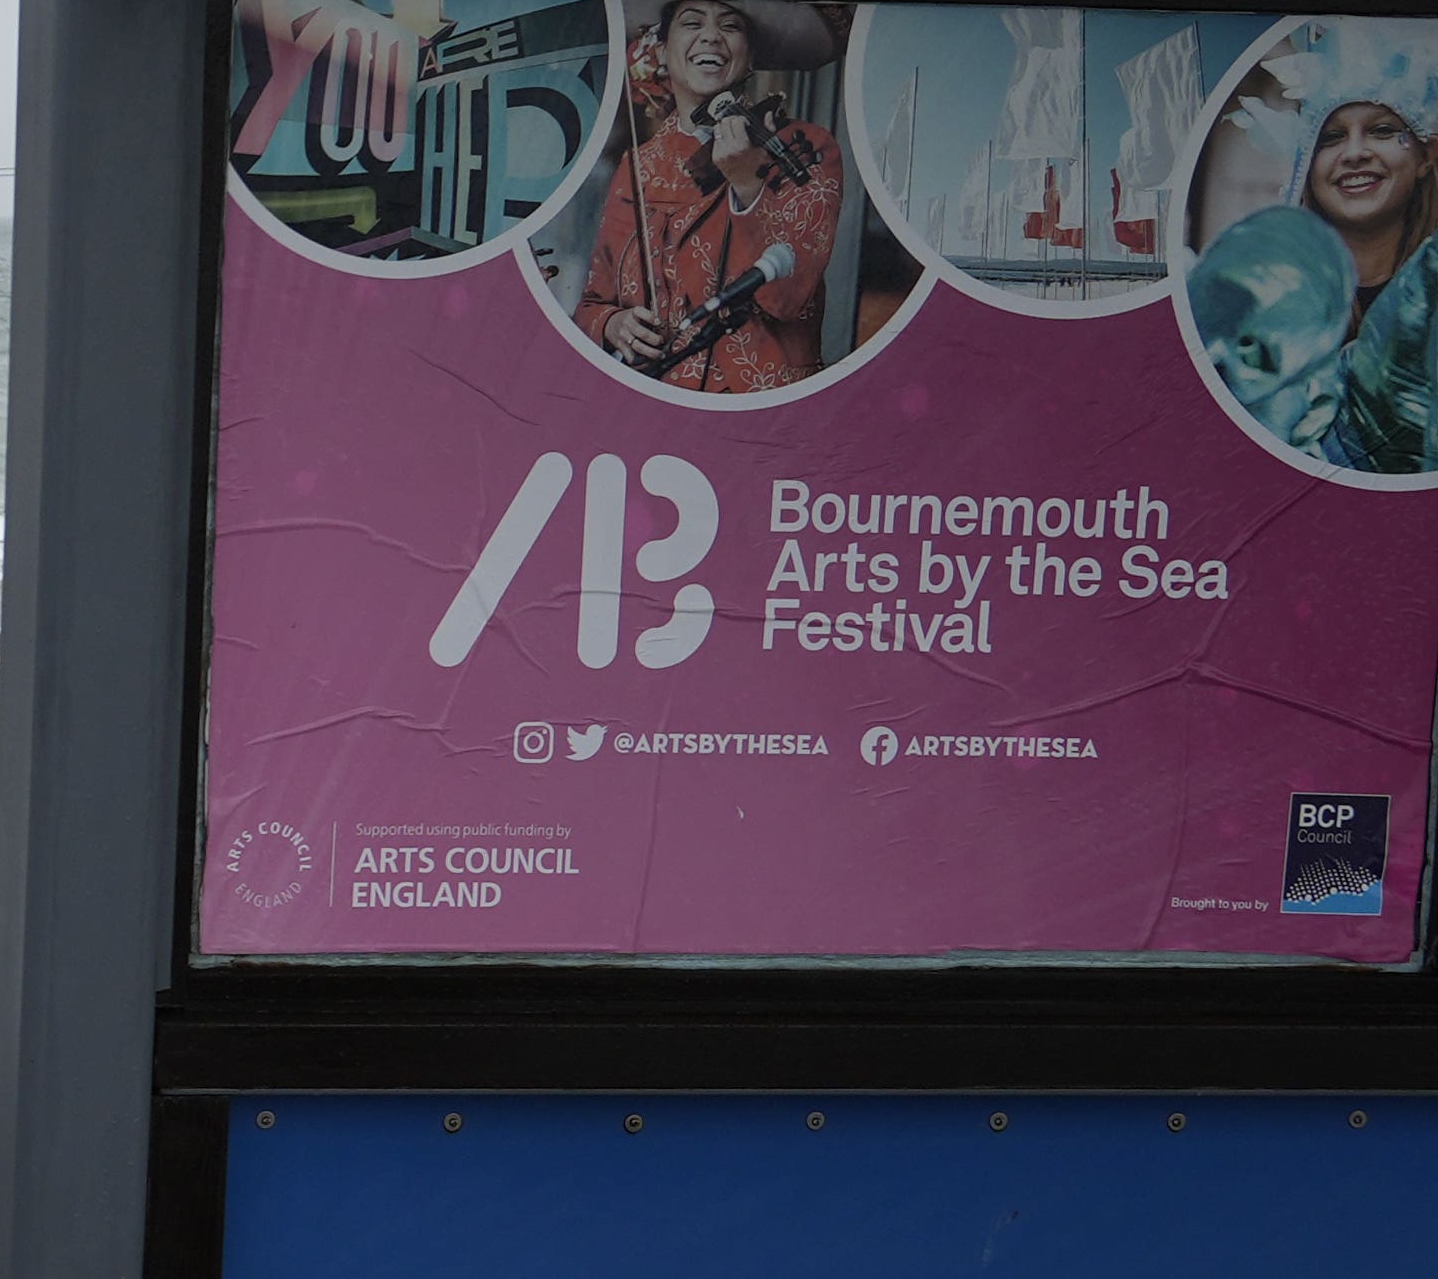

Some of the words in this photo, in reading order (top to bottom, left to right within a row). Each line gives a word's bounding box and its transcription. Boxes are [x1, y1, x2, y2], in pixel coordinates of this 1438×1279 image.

[769, 479, 1170, 540] Bournemouth
[766, 538, 900, 594] Arts
[918, 540, 991, 609] by
[1005, 542, 1102, 597] the
[1118, 544, 1229, 601] Sea
[761, 598, 992, 654] Festival
[613, 732, 829, 755] @ARTSBYTHESEA
[904, 735, 1099, 758] ARTSBYTHESEA
[1298, 803, 1355, 829] BCP
[355, 823, 424, 838] Supported
[426, 824, 460, 839] using
[462, 823, 501, 839] public
[504, 823, 554, 839] funding
[556, 824, 572, 840] by
[1296, 829, 1353, 845] Council
[226, 830, 253, 873] ARTS
[258, 821, 313, 872] COUNCIL
[353, 847, 436, 874] ARTS
[444, 847, 580, 874] COUNCIL
[234, 882, 302, 909] ENGLAND
[351, 881, 502, 908] ENGLAND
[1170, 896, 1216, 911] Brought
[1218, 898, 1230, 909] to
[1231, 900, 1252, 912] you
[1254, 899, 1269, 912] by
